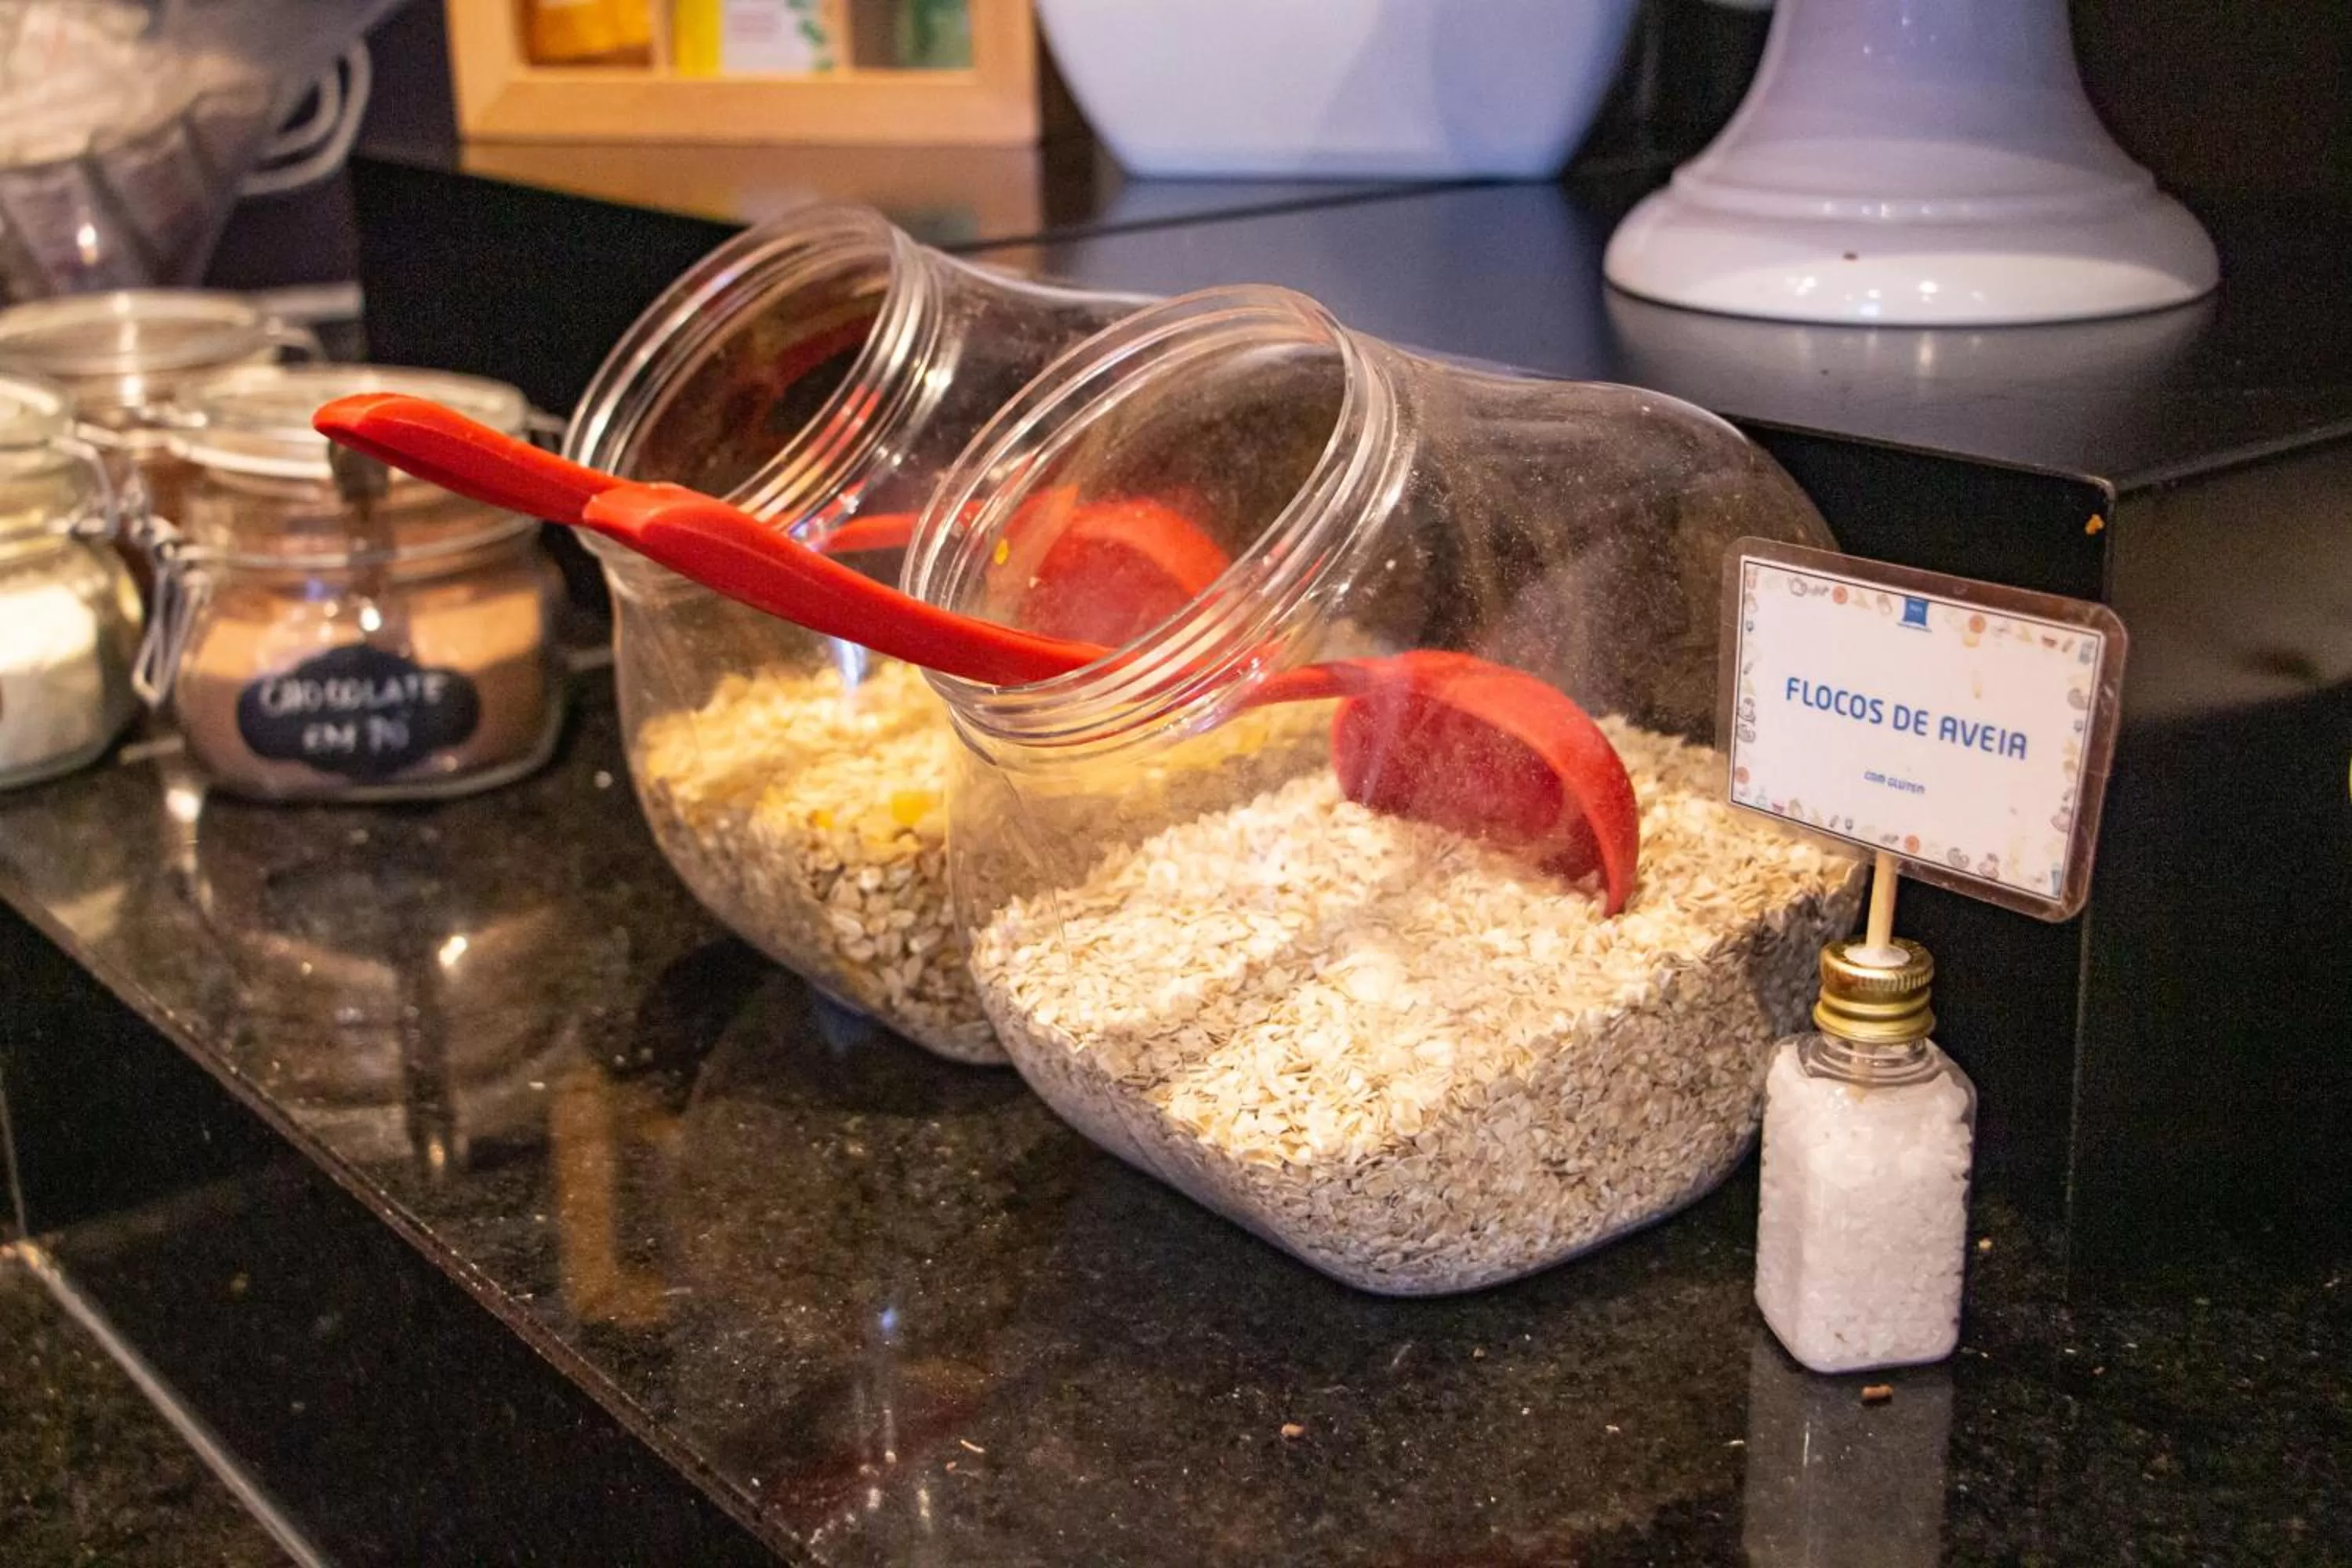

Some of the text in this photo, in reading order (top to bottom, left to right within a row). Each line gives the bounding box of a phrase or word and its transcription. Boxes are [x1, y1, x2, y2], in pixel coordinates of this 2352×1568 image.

[259, 672, 448, 717] CHOCOLATE
[1786, 677, 2027, 760] FLOCOS DE AVEIA
[1864, 771, 1926, 793] COM GLUTEN
